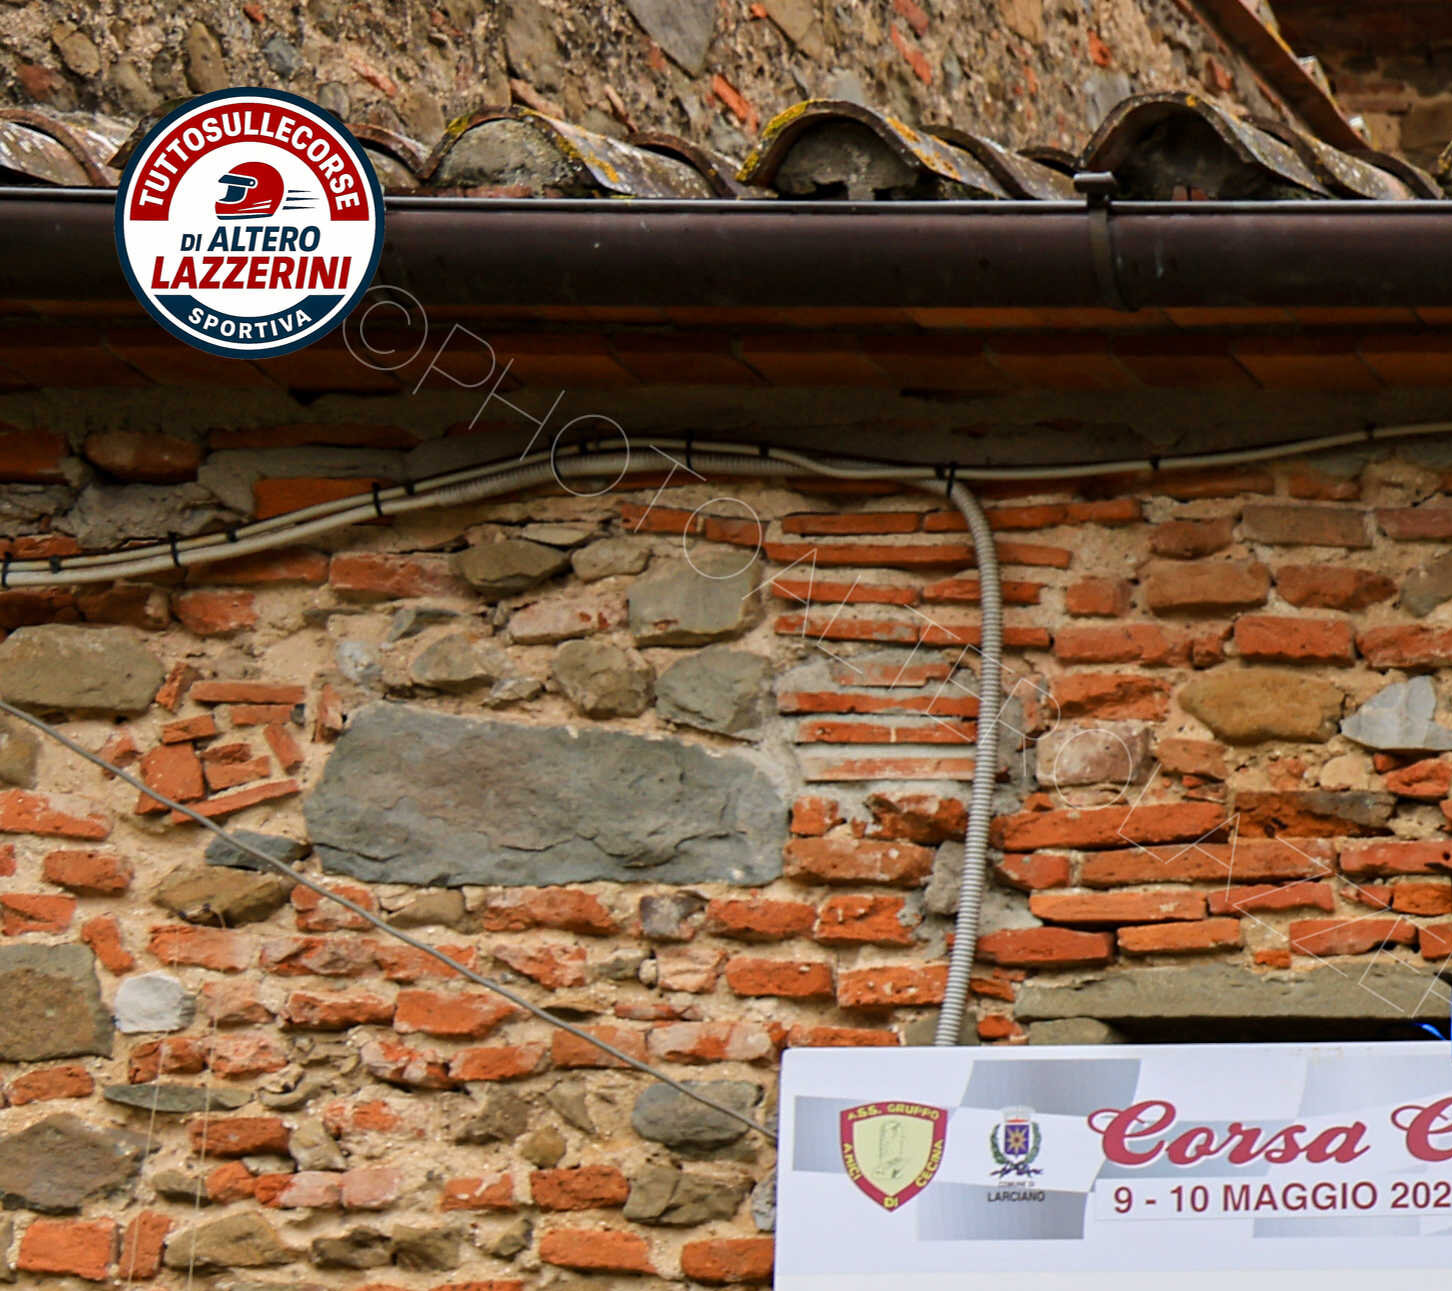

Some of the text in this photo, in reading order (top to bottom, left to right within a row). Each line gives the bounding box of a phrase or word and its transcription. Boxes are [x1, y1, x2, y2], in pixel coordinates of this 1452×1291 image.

[887, 1102, 940, 1120] GRUPPO
[1087, 1097, 1368, 1170] Corsa
[842, 1142, 862, 1182] AMICI
[915, 1139, 944, 1188] CECINA
[987, 1190, 1045, 1202] LARCIANO
[1114, 1187, 1131, 1213] 9
[1171, 1186, 1208, 1212] 10
[1222, 1184, 1379, 1214] MAGGIO
